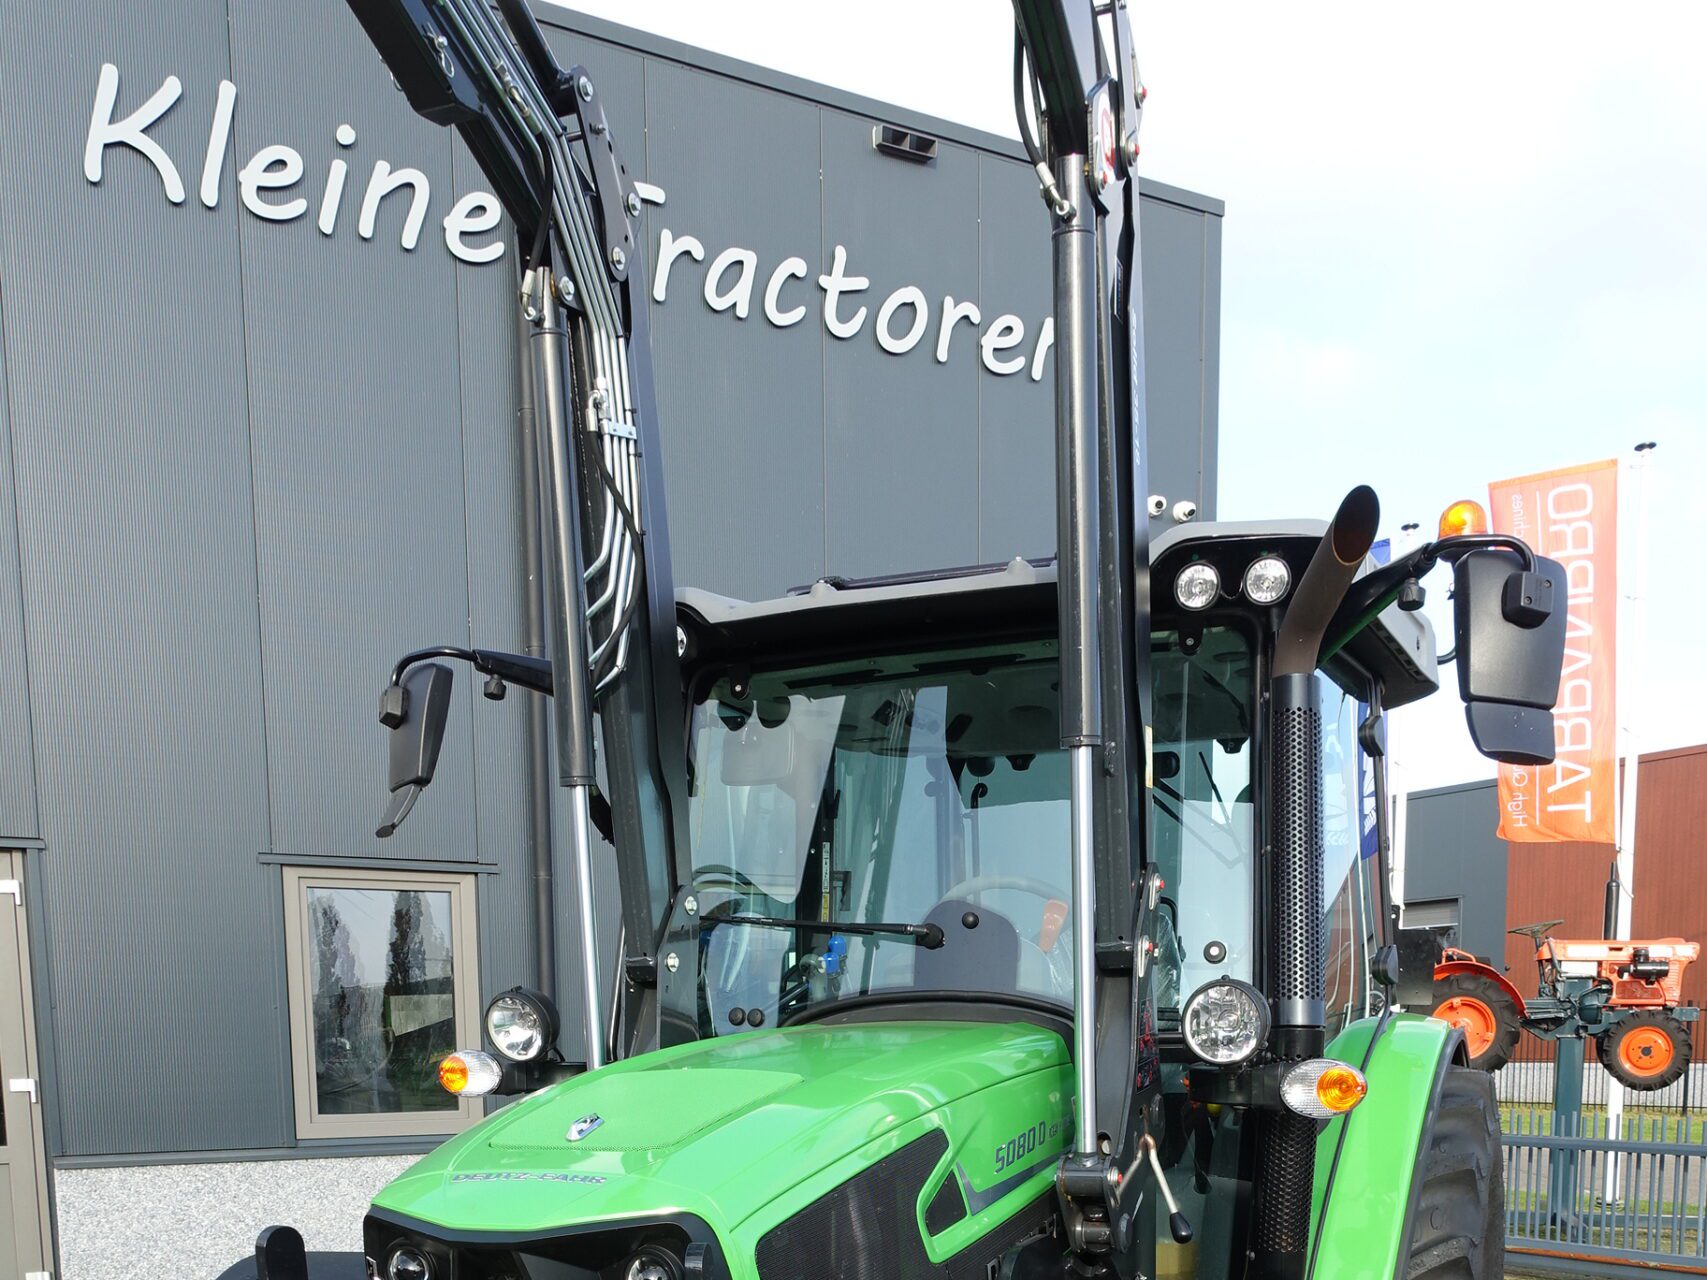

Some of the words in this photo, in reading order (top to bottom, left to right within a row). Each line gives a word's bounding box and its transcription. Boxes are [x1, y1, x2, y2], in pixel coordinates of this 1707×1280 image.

[83, 63, 505, 263] Kleine
[994, 1126, 1036, 1174] 5080
[452, 1171, 607, 1185] DEUTZ-FAHR
